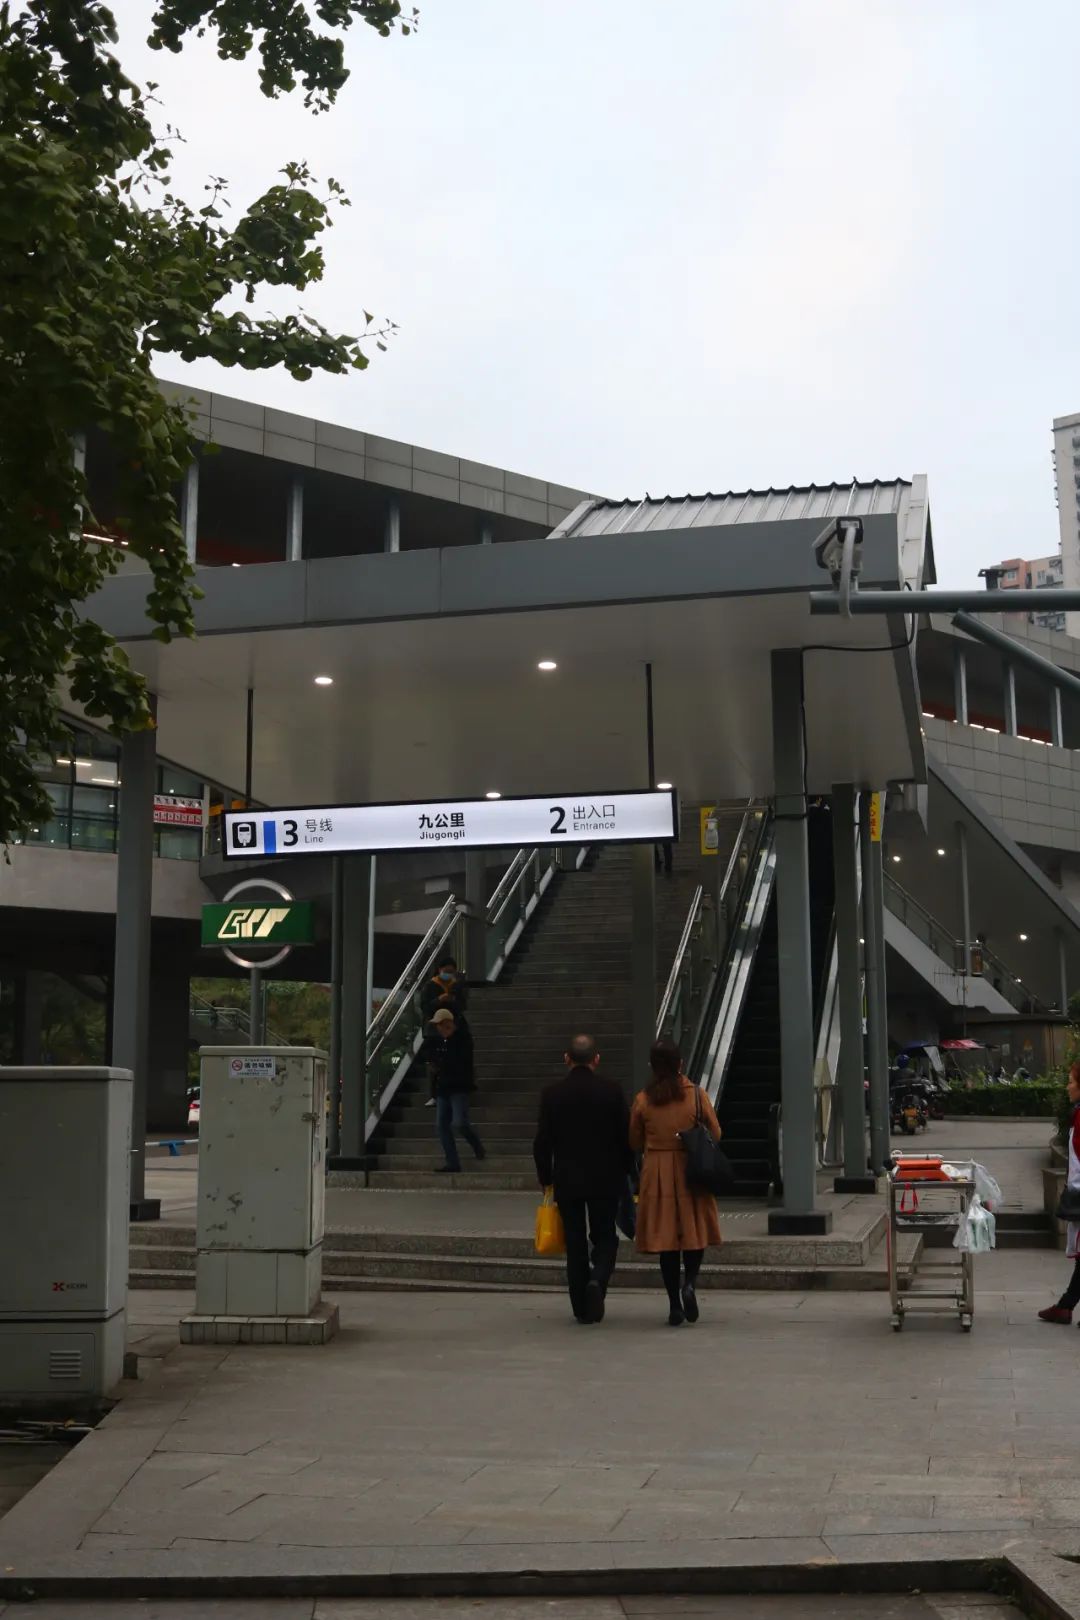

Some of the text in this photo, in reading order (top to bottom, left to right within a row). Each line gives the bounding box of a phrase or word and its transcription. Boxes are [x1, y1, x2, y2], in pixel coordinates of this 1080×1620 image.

[573, 804, 615, 820] 出入口
[305, 818, 333, 833] 号线
[418, 812, 465, 829] 九公里
[549, 806, 567, 834] 2
[573, 821, 616, 831] Entrance
[283, 819, 299, 847] 3
[304, 835, 324, 844] Line
[419, 829, 465, 841] Jiugongli
